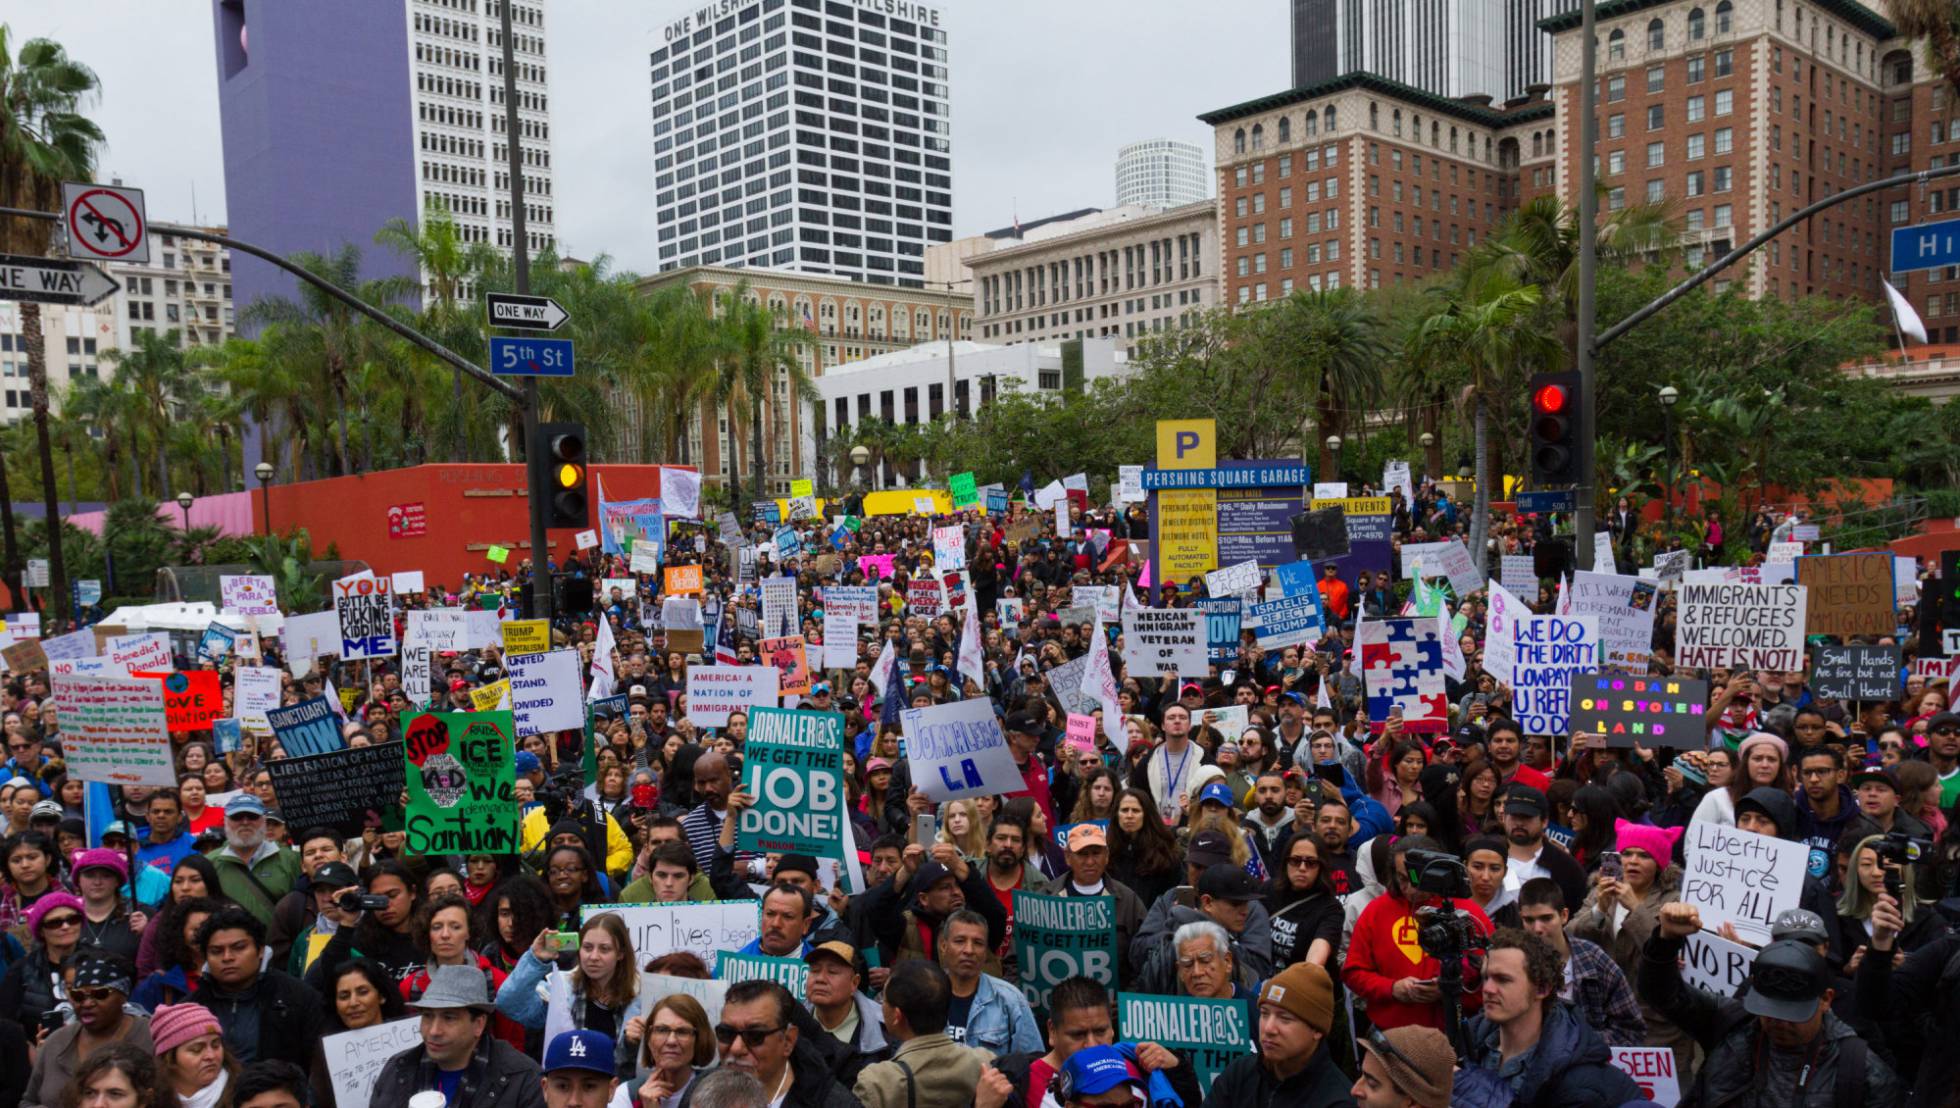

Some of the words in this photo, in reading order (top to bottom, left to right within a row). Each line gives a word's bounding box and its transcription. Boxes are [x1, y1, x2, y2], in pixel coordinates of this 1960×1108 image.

[665, 17, 691, 41] ONE
[40, 271, 85, 293] WAY
[497, 304, 520, 317] ONE
[523, 306, 545, 320] WAY
[503, 344, 535, 368] 5th
[543, 348, 564, 367] St
[1176, 431, 1200, 459] P
[1146, 471, 1205, 487] PERSHING
[1210, 470, 1256, 487] SQUARE
[1261, 468, 1306, 484] GARAGE
[1192, 503, 1213, 512] SQUARE
[1240, 502, 1256, 511] Daily
[1354, 500, 1386, 512] EVENTS
[1552, 502, 1565, 510] 500
[1256, 535, 1276, 544] Before
[1168, 553, 1210, 561] AUTOMATED
[1801, 554, 1891, 583] AMERICA
[237, 591, 263, 601] PARA
[336, 579, 388, 599] YOU
[1580, 583, 1592, 598] IF
[1683, 585, 1800, 606] IMMIGRANTS
[1814, 585, 1881, 611] NEEDS
[375, 594, 389, 606] BE
[1197, 600, 1240, 614] SANCTUARY
[1255, 594, 1311, 616] ISRAELIS
[239, 606, 277, 616] PUEBLO
[339, 606, 390, 627] FUCKING
[1137, 612, 1189, 621] MEXICAN
[1261, 609, 1307, 625] REJECT
[1573, 601, 1588, 613] TO
[1590, 601, 1636, 618] REMAIN
[1683, 605, 1697, 625] &
[1701, 605, 1796, 628] REFUGEES
[341, 623, 391, 639] KIDDING
[504, 627, 534, 637] TRUMP
[1133, 622, 1196, 632] IMMIGRANT
[1266, 618, 1308, 635] TRUMP
[1514, 619, 1545, 642] WE
[1549, 618, 1585, 644] DO
[342, 635, 393, 658] ME
[1140, 635, 1196, 645] VETERAN
[1681, 627, 1788, 648] WELCOMED.
[112, 640, 160, 664] Benedict
[404, 647, 428, 663] WE
[506, 644, 546, 653] CAPITALISM
[1159, 649, 1174, 658] OF
[1514, 642, 1548, 665] THE
[1550, 643, 1597, 666] DIRTY
[126, 651, 171, 675] Donald!
[509, 654, 545, 667] UNITED
[1156, 662, 1179, 672] WAR
[1680, 646, 1725, 668] HATE
[1731, 649, 1749, 668] IS
[1752, 649, 1798, 671] NOT!
[1821, 649, 1851, 667] Small
[1860, 650, 1895, 667] Hands
[55, 663, 73, 674] NO
[76, 661, 104, 671] Human
[404, 664, 429, 679] ARE
[509, 668, 525, 678] WE
[1815, 666, 1832, 678] Are
[1835, 666, 1853, 679] fine
[1857, 665, 1875, 679] but
[1879, 667, 1897, 680] not
[693, 673, 742, 683] AMERICA:
[746, 674, 753, 682] A
[1596, 679, 1626, 691] NO
[1633, 679, 1681, 694] BAN
[404, 682, 429, 695] ALL
[693, 688, 734, 698] NATION
[738, 689, 753, 698] OF
[1818, 684, 1853, 699] Small
[1859, 681, 1893, 698] Heart
[514, 698, 554, 711] DIVIDED
[692, 703, 752, 713] IMMIGRANT
[1513, 689, 1529, 714] U
[1580, 698, 1609, 712] ON
[1622, 699, 1704, 716] STOLEN
[269, 700, 329, 730] SANCTUARY
[515, 713, 530, 723] WE
[518, 725, 540, 737] FALL
[748, 711, 841, 750] JORNALER@S:
[1514, 714, 1546, 735] TO
[1596, 720, 1666, 735] LAND
[277, 717, 342, 758] NOW
[406, 720, 448, 761] STOP
[460, 739, 503, 763] ICE
[748, 747, 772, 762] WE
[772, 749, 804, 767] GET
[806, 751, 839, 769] THE
[270, 756, 348, 777] LIBERATION
[938, 758, 985, 792] LA
[745, 765, 838, 813] JOB
[405, 808, 518, 855] Santuary
[740, 809, 839, 841] DONE!
[1697, 824, 1779, 876] Liberty
[1685, 879, 1726, 911] FOR
[1736, 890, 1775, 927] ALL
[1014, 894, 1113, 931] JORNALER@S:
[1781, 914, 1820, 929] NIKE
[671, 910, 713, 948] lives
[1018, 928, 1040, 946] WE
[1042, 931, 1074, 948] GET
[1077, 931, 1111, 948] THE
[1020, 944, 1113, 987] JOB
[1679, 936, 1720, 978] NO
[1121, 998, 1247, 1047] JORNALER@S:
[1618, 1051, 1673, 1079] SEEN
